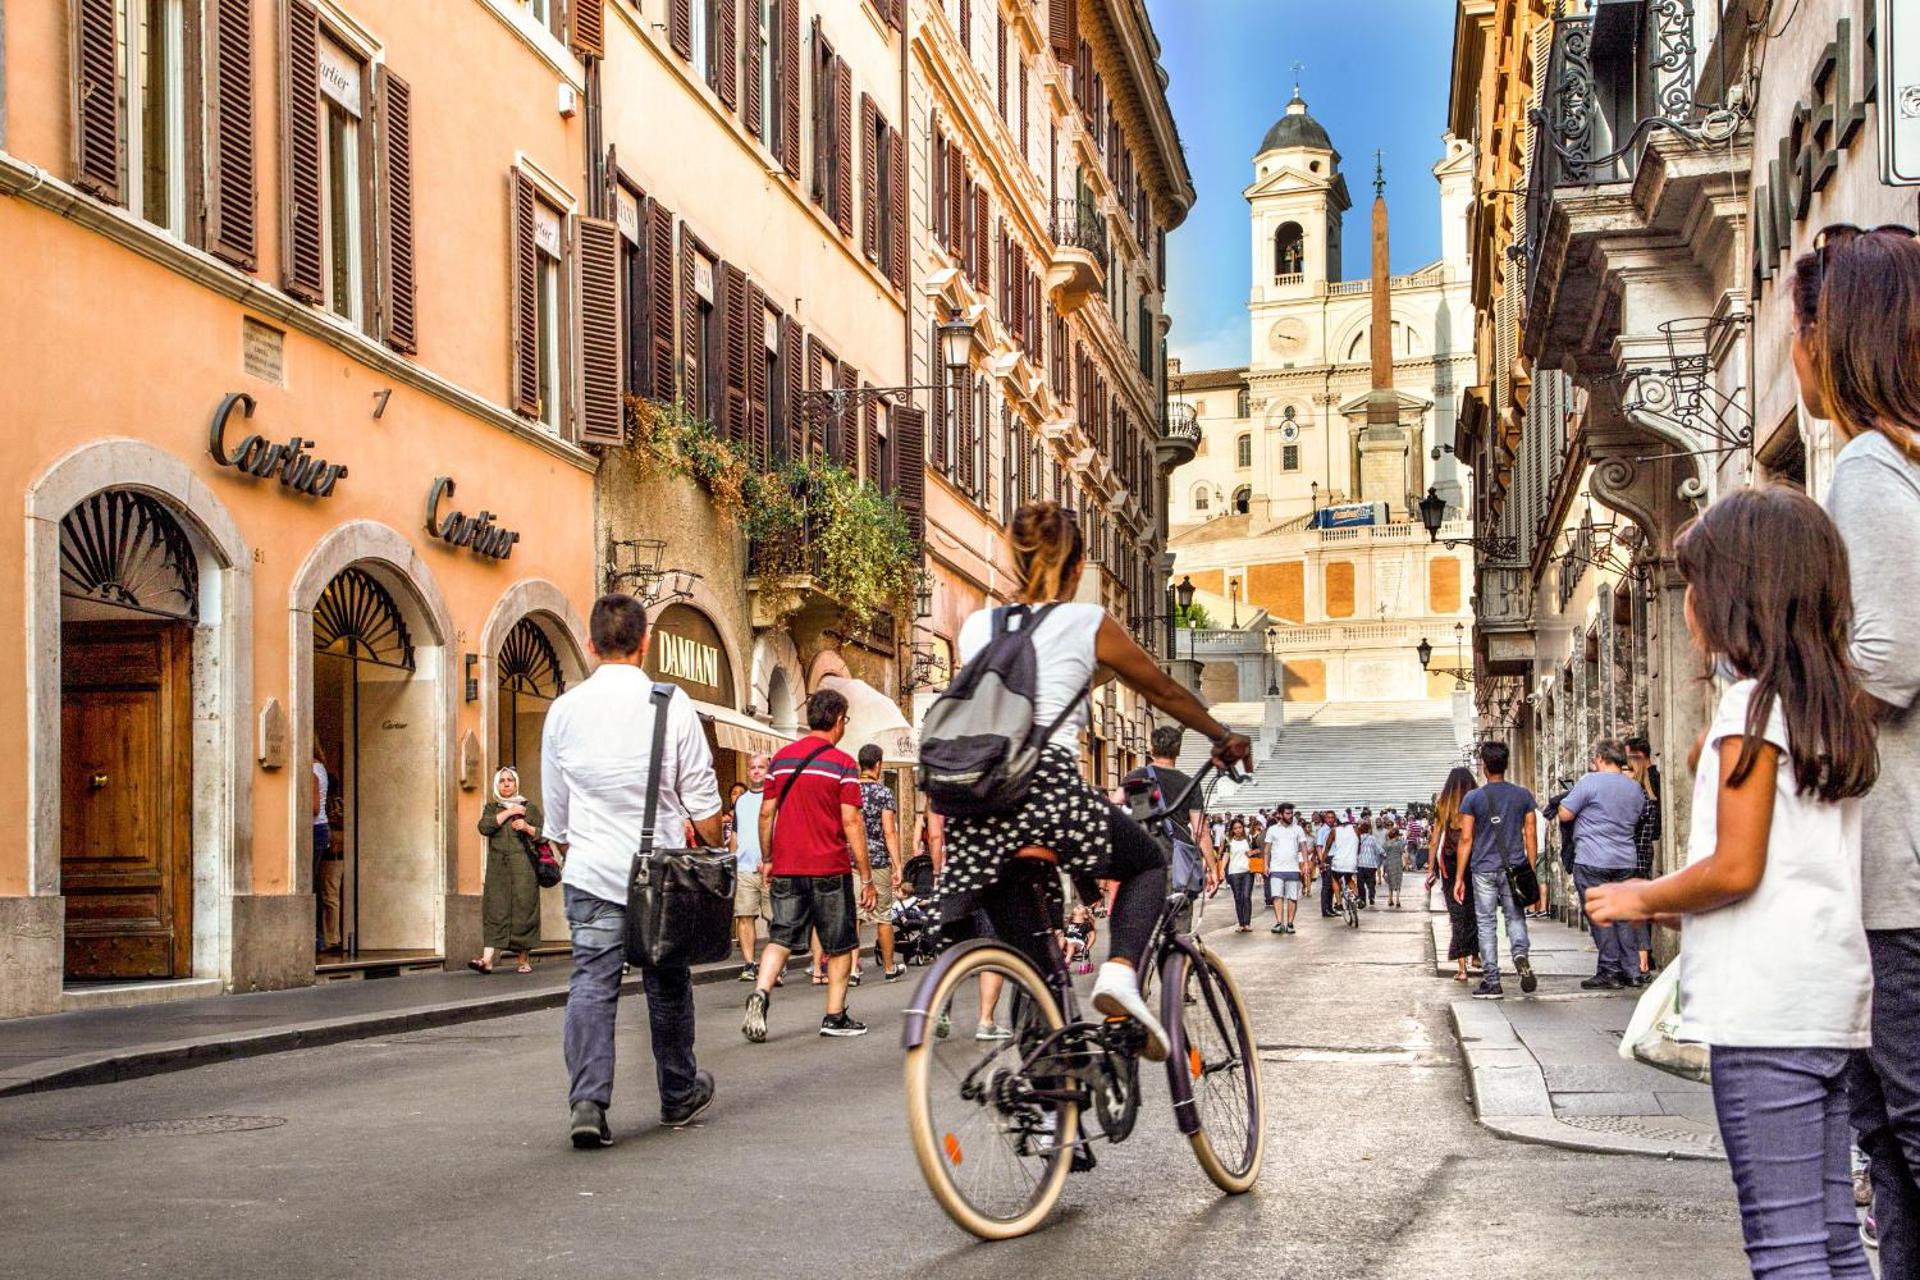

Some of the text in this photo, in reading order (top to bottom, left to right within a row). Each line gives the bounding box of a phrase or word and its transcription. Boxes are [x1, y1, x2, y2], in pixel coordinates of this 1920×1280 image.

[209, 392, 348, 497] Cartier
[426, 476, 519, 560] Cartier
[658, 630, 718, 688] DAMIANI
